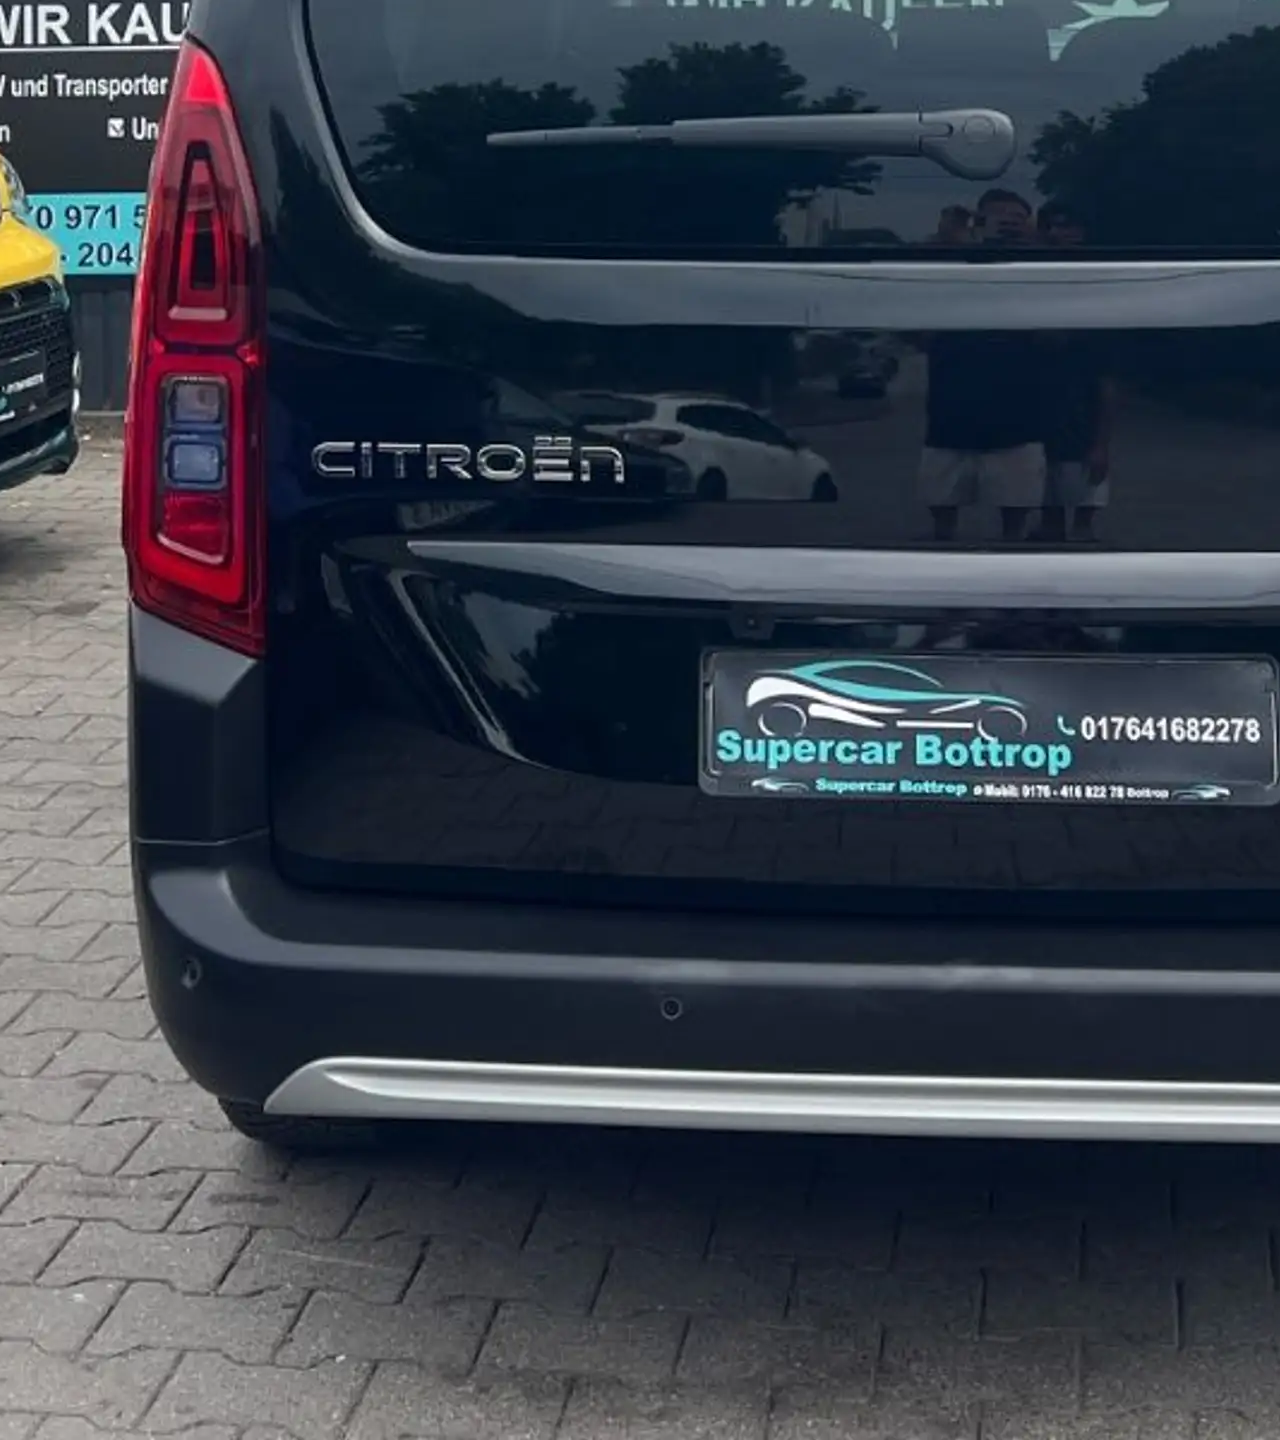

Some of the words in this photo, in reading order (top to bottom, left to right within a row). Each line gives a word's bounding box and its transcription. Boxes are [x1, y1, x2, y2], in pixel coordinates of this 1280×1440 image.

[11, 74, 49, 97] und
[53, 74, 168, 101] Transporter
[64, 204, 118, 230] 971
[311, 436, 626, 484] CITROËN
[1080, 715, 1262, 743] 017641682278
[717, 729, 903, 769] Supercar
[915, 733, 1073, 777] Bottrop
[814, 777, 897, 795] Supercar
[899, 779, 968, 797] Bottrop
